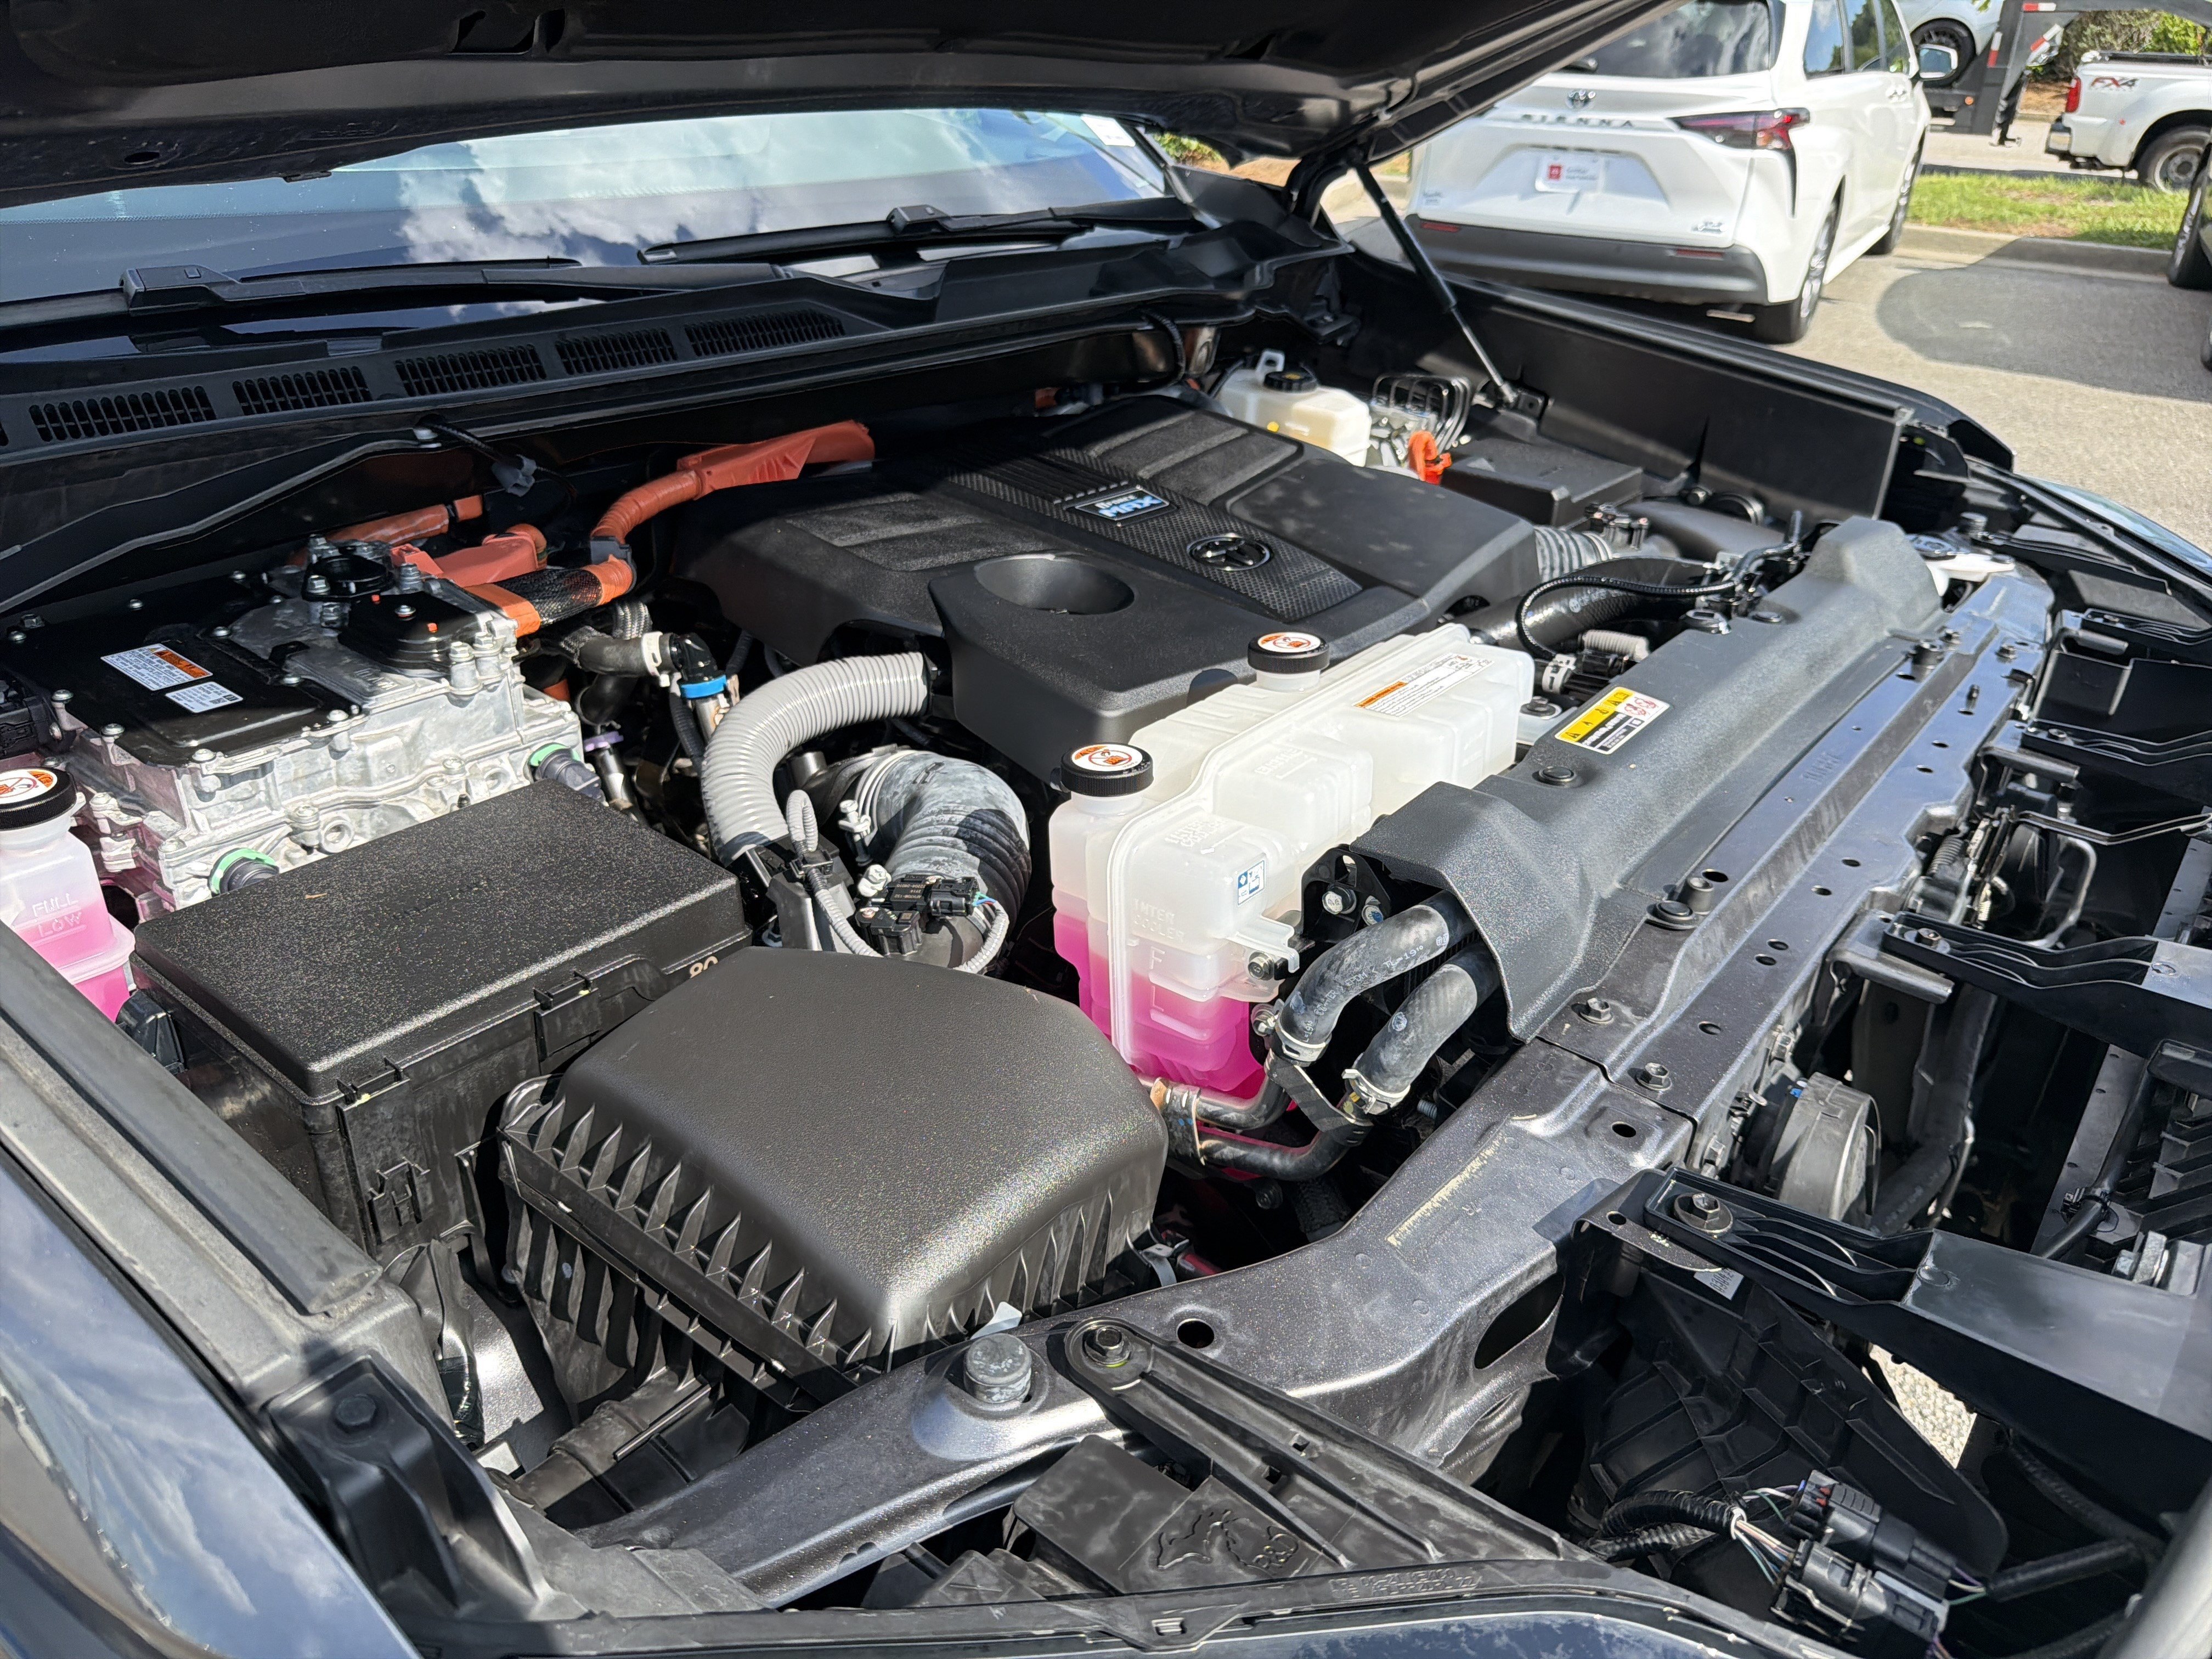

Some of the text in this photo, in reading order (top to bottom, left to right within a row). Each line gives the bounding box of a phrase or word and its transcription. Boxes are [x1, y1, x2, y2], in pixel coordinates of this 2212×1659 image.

[2090, 76, 2139, 92] FX4
[1520, 113, 1634, 128] SIENNA
[1098, 495, 1163, 517] MAX
[32, 893, 79, 919] FULL
[1134, 898, 1175, 924] INTER
[38, 911, 82, 938] LOW
[1133, 914, 1184, 943] COOLER
[1149, 946, 1165, 969] F
[1150, 984, 1165, 1012] L
